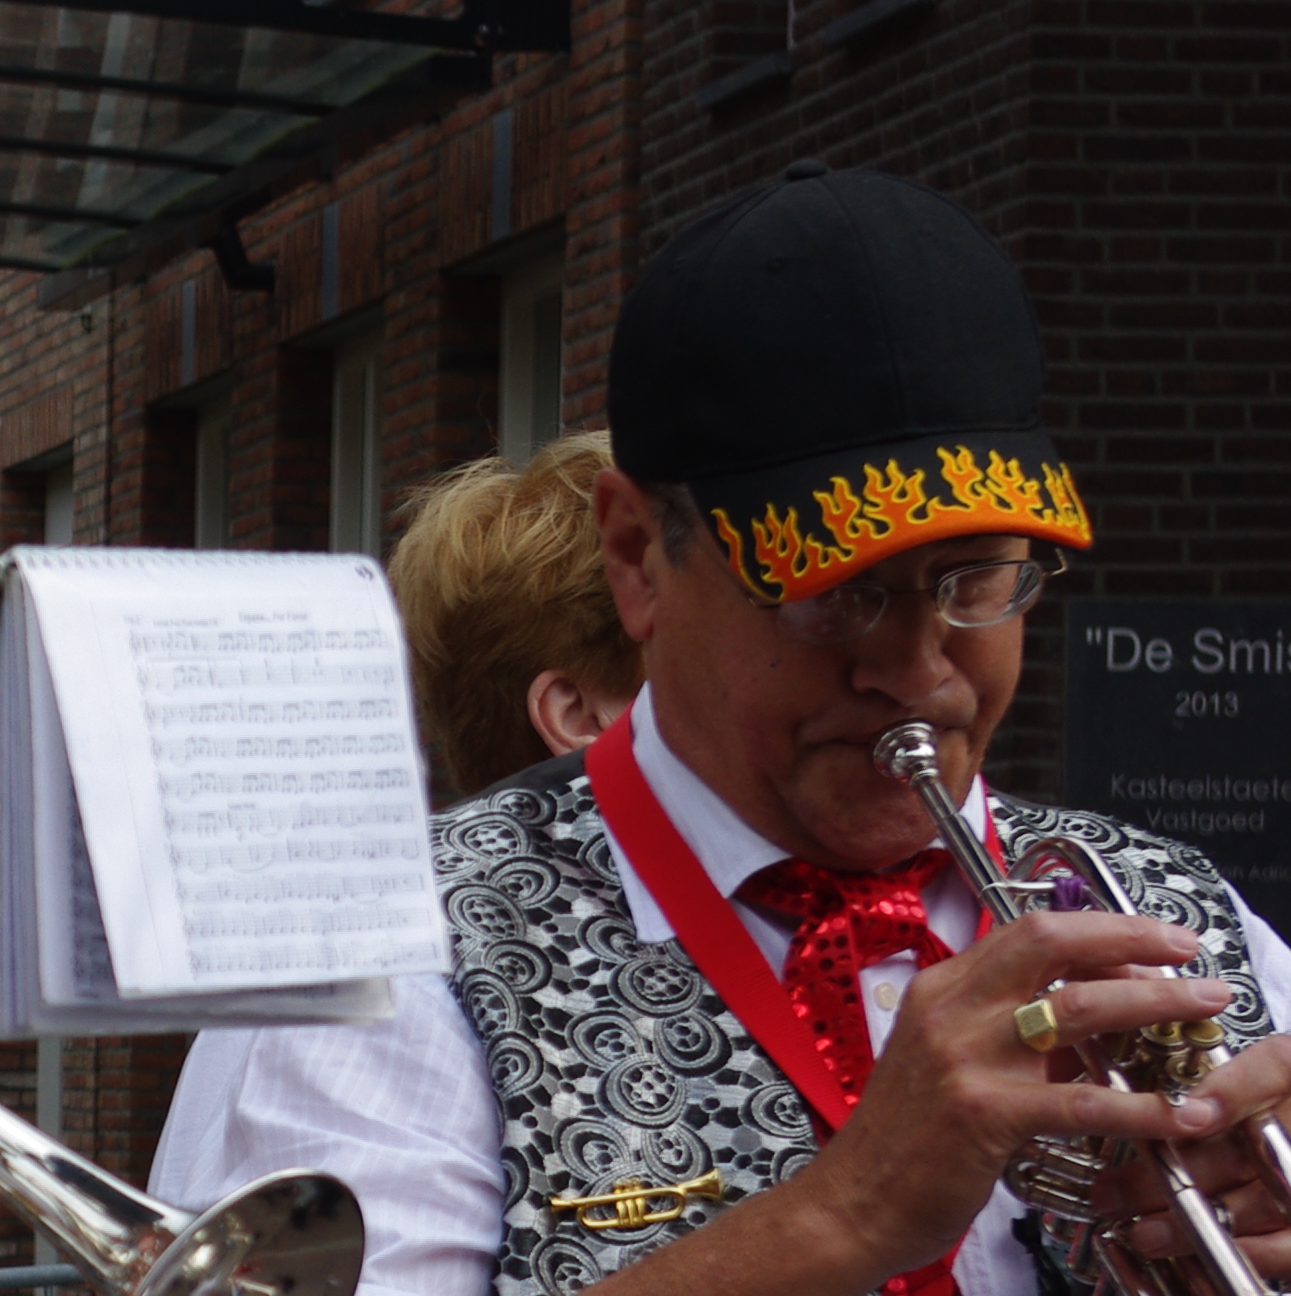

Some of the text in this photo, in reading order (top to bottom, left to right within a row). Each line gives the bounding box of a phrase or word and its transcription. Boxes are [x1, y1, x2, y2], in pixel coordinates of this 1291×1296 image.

[1085, 626, 1173, 673] "De
[1175, 690, 1240, 718] 2013
[1145, 807, 1265, 836] Vastgoed
